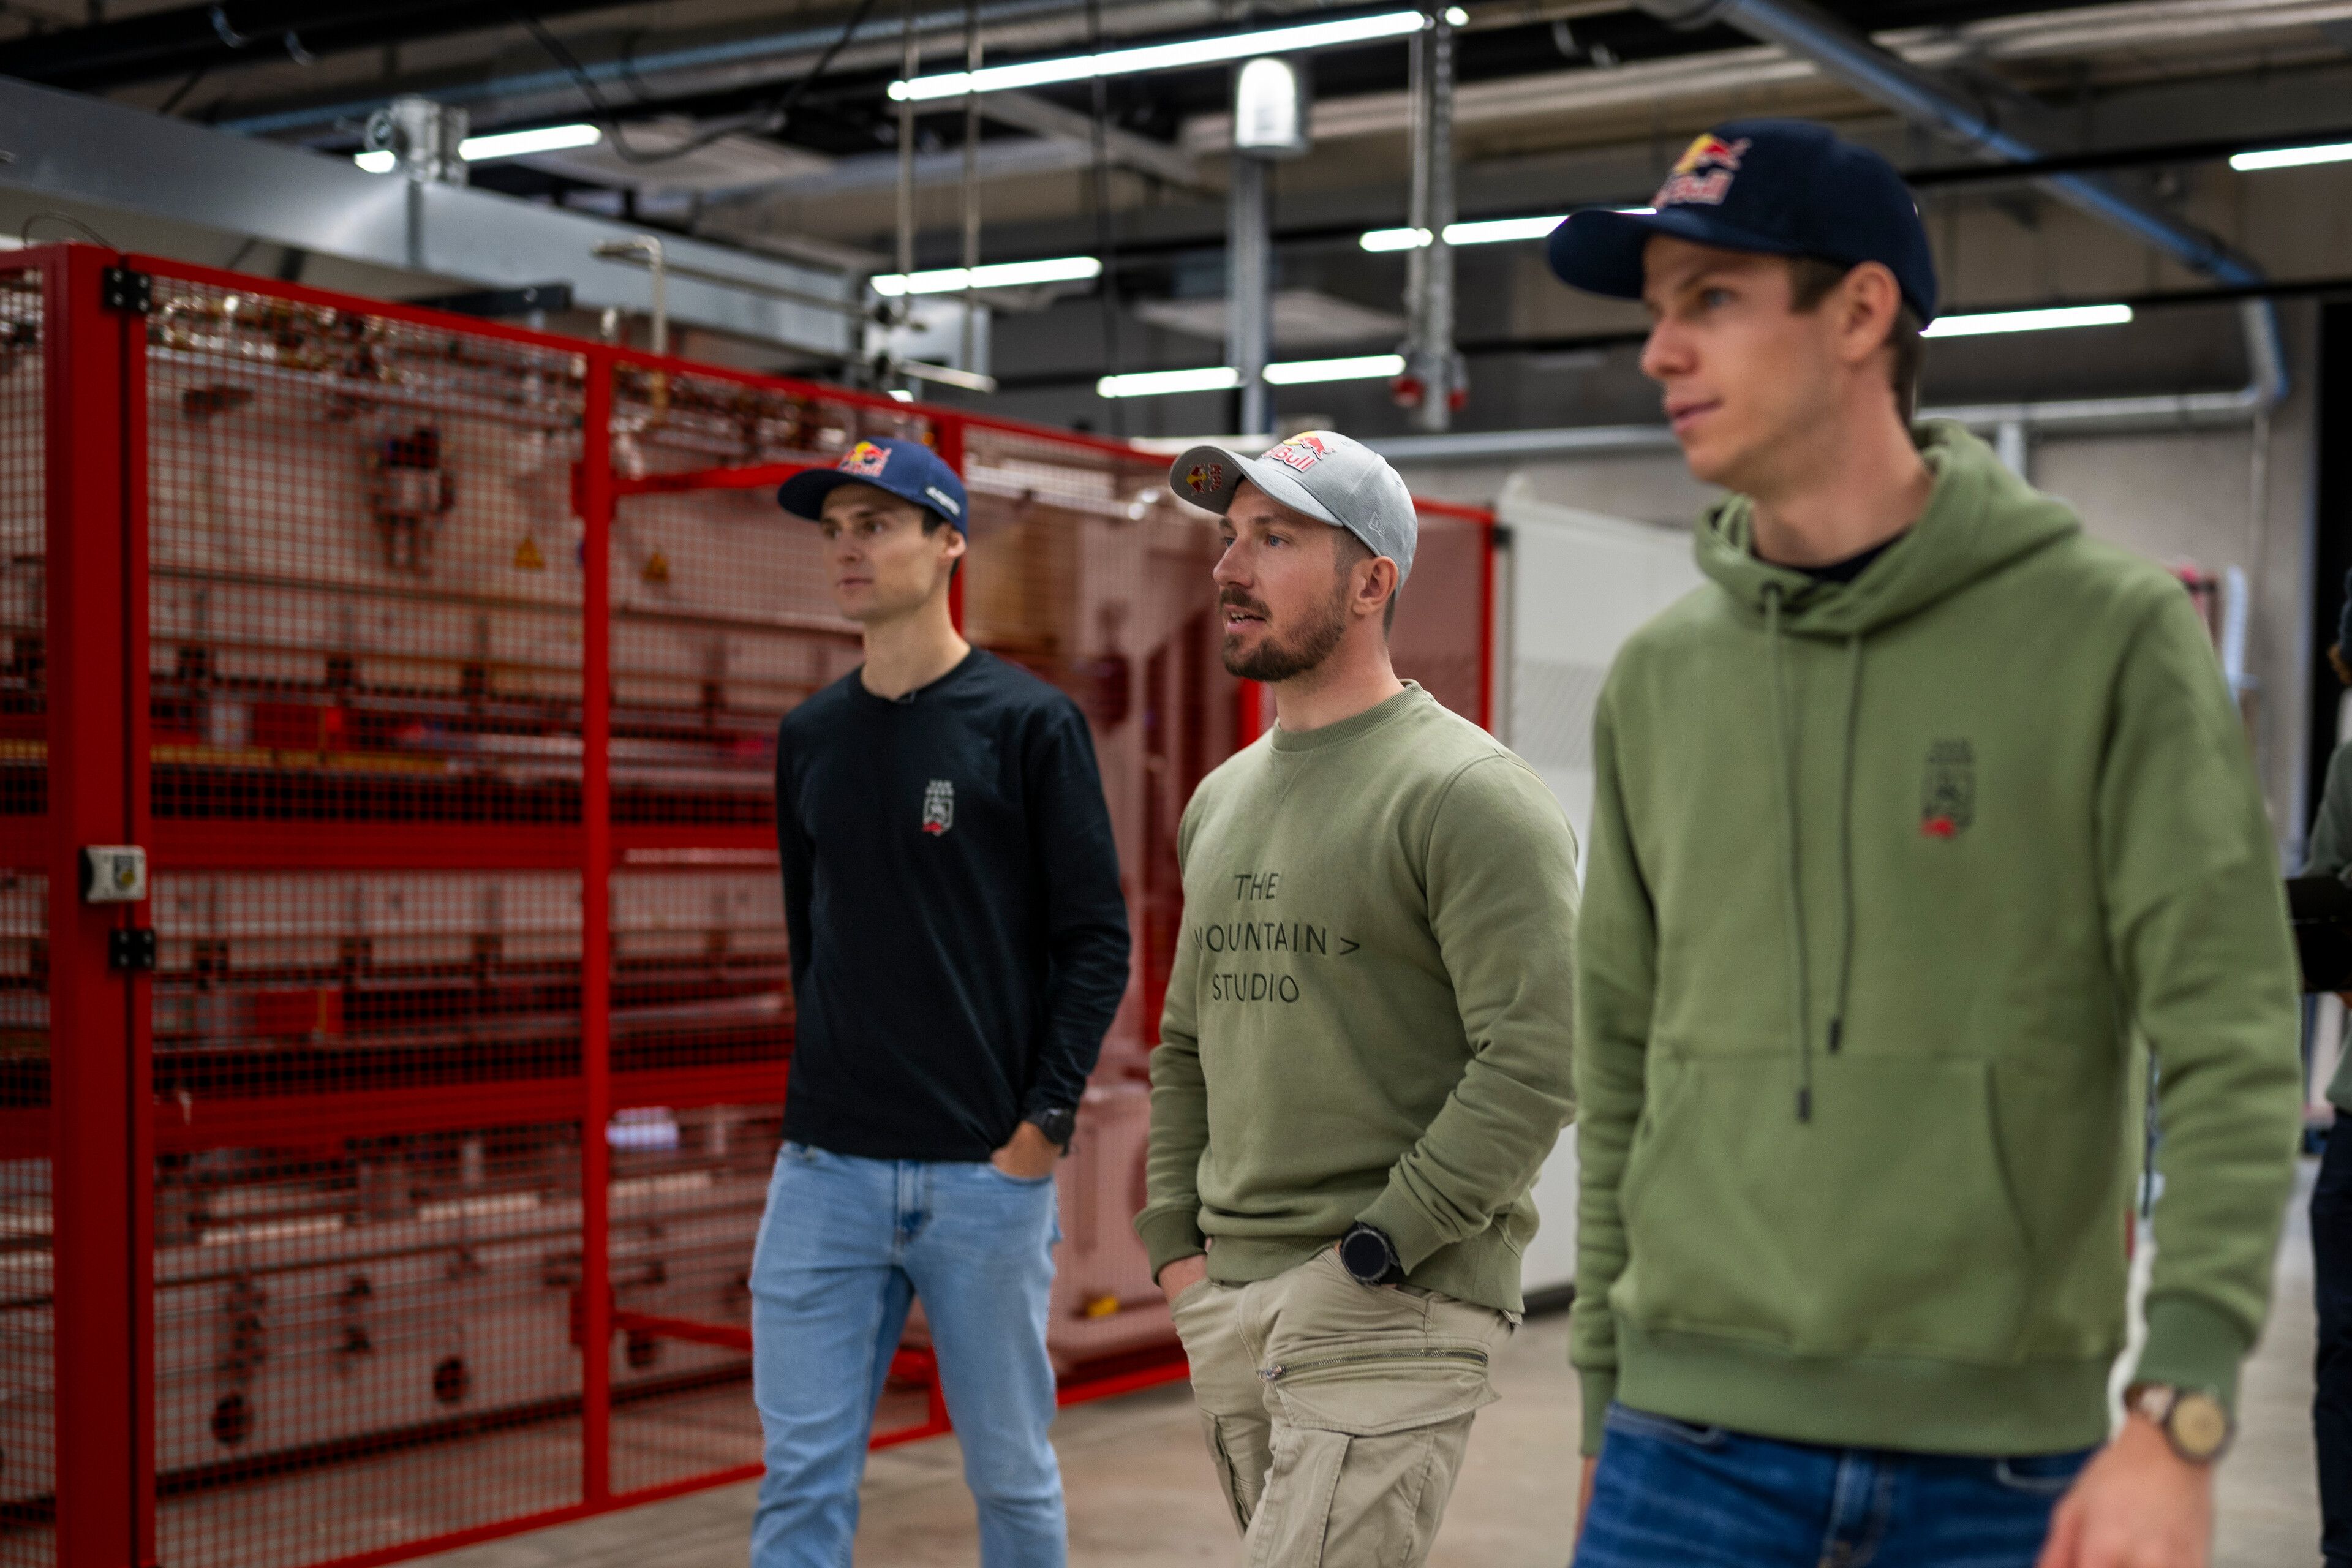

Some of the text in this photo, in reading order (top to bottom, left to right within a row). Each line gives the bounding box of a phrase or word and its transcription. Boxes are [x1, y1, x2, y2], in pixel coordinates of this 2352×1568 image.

[1272, 444, 1315, 470] Bull
[1235, 872, 1279, 901] THE
[1212, 973, 1300, 1003] STUDIO
